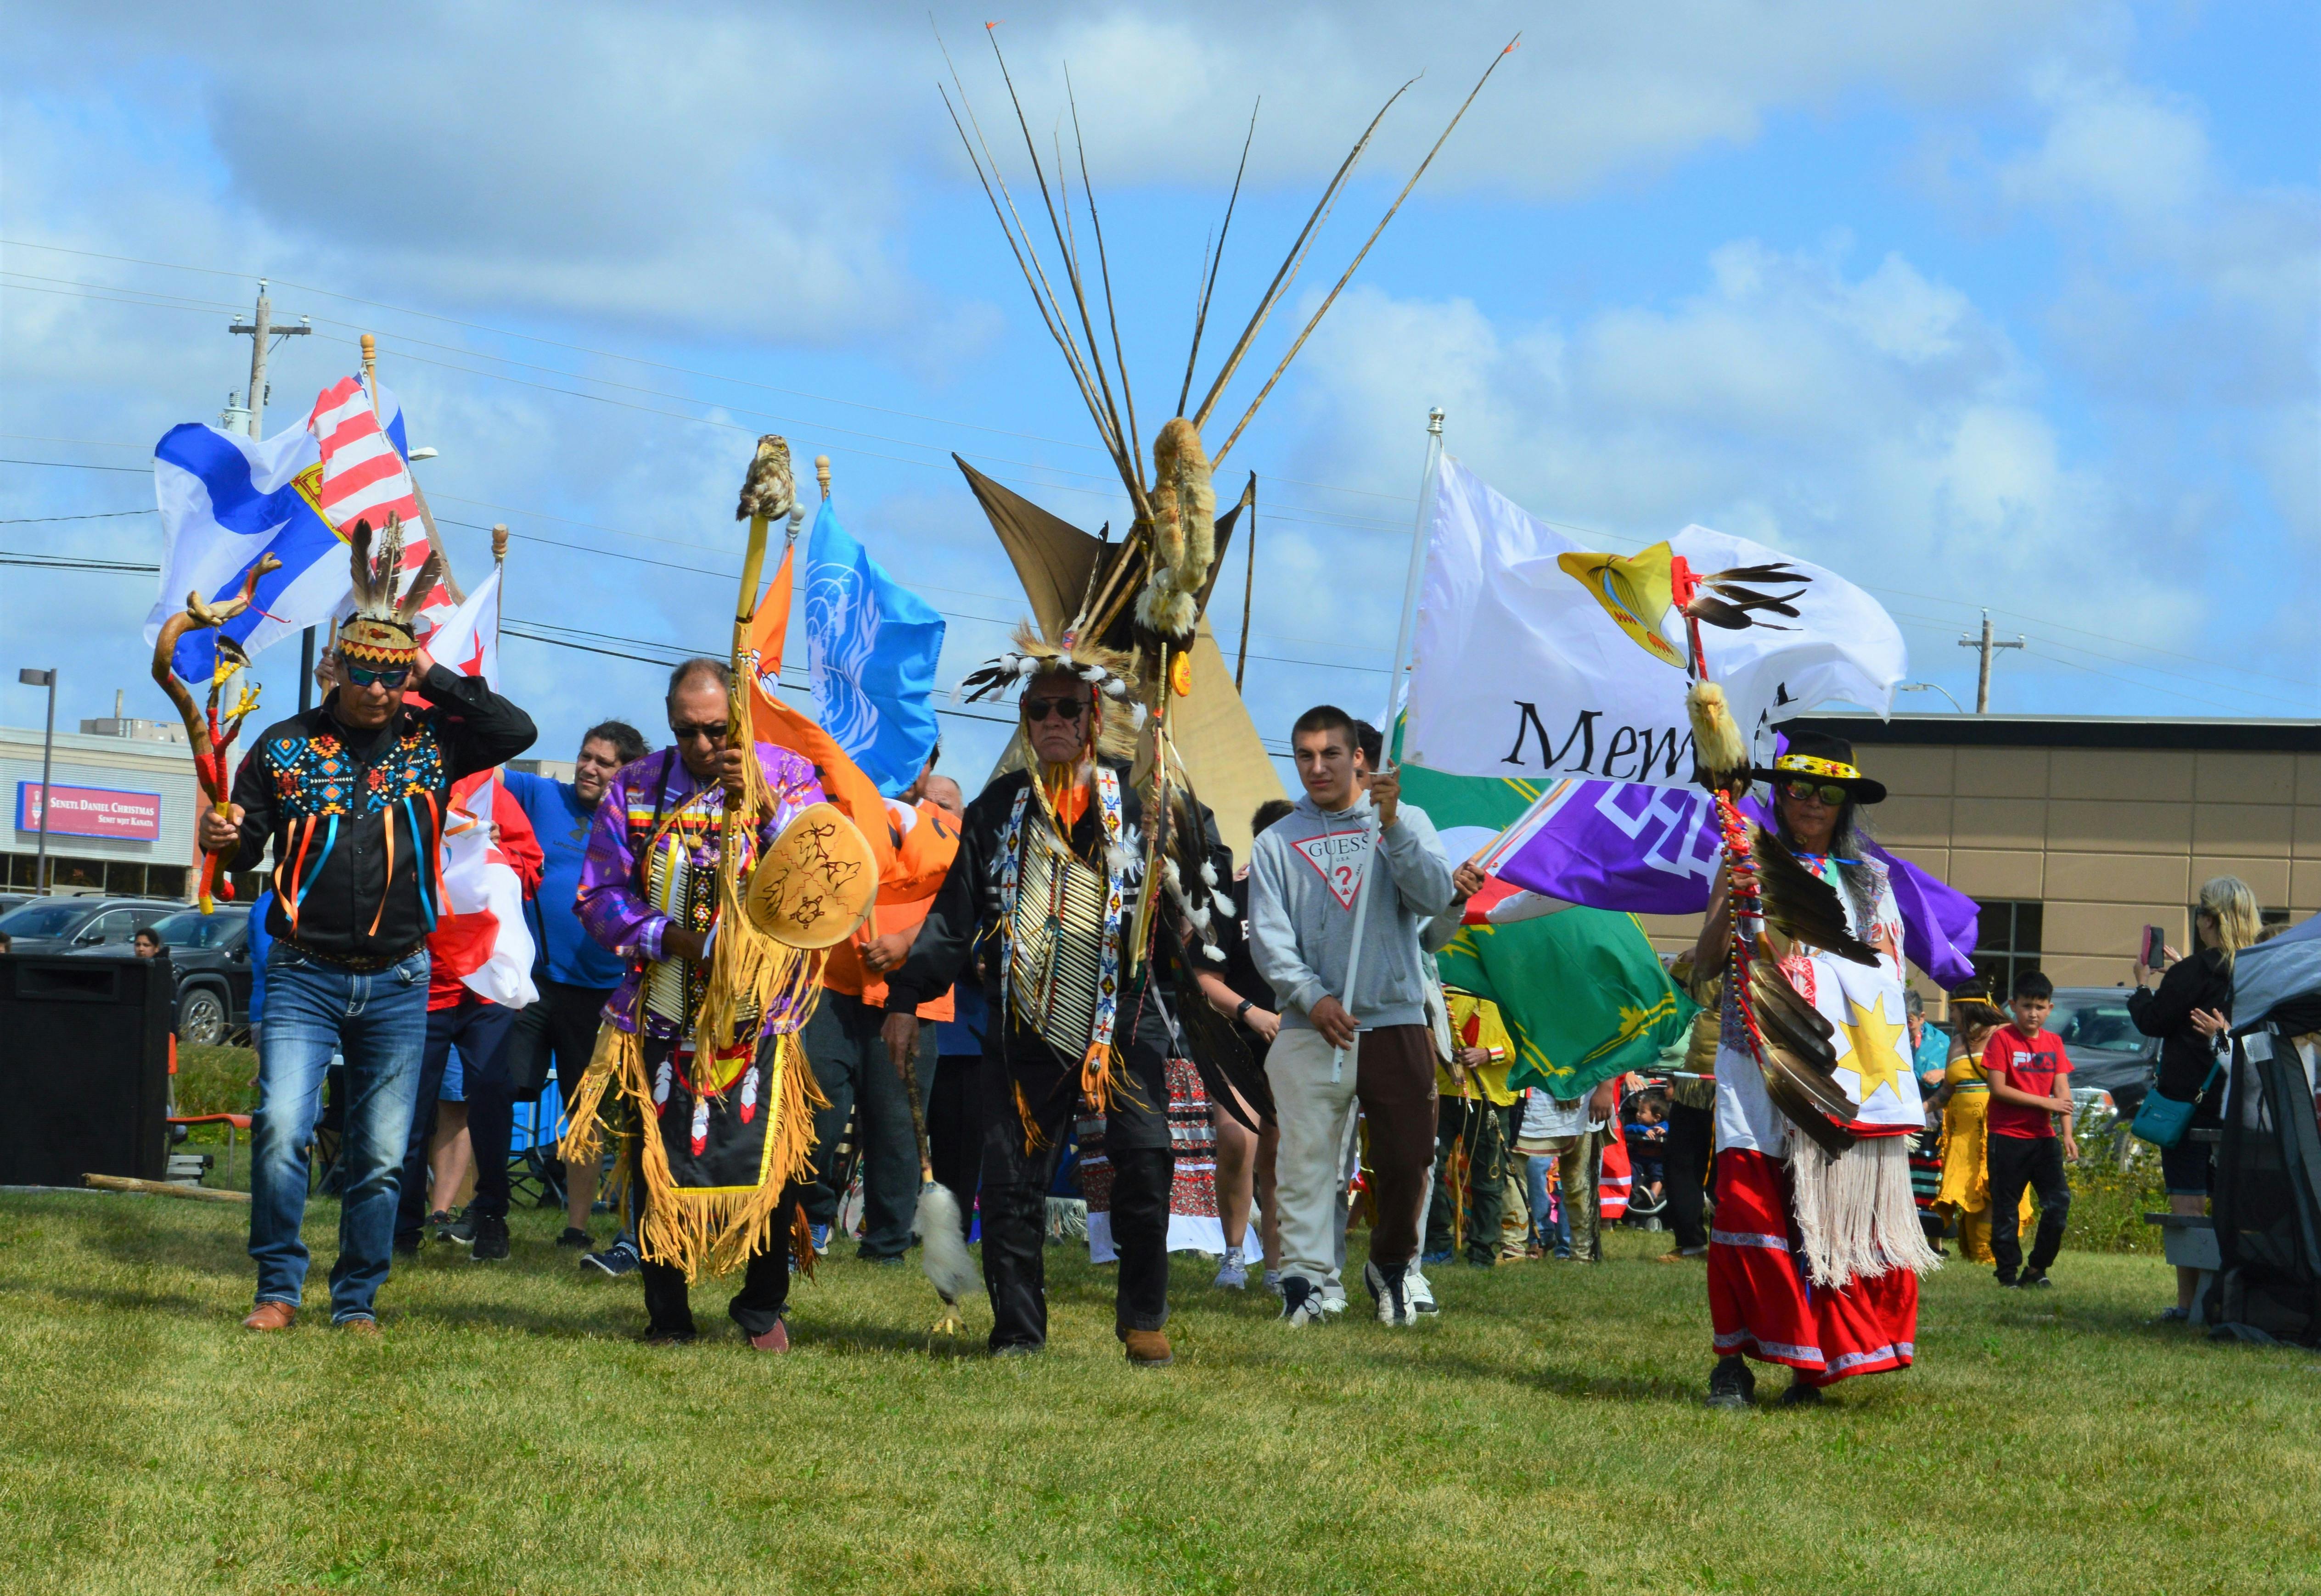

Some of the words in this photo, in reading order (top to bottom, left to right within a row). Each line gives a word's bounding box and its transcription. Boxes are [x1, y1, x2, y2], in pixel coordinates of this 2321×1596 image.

[51, 797, 79, 809] SENETL
[80, 800, 109, 812] DANIEL
[111, 802, 154, 816] CHRISTMAS
[1309, 835, 1368, 857] GUESS
